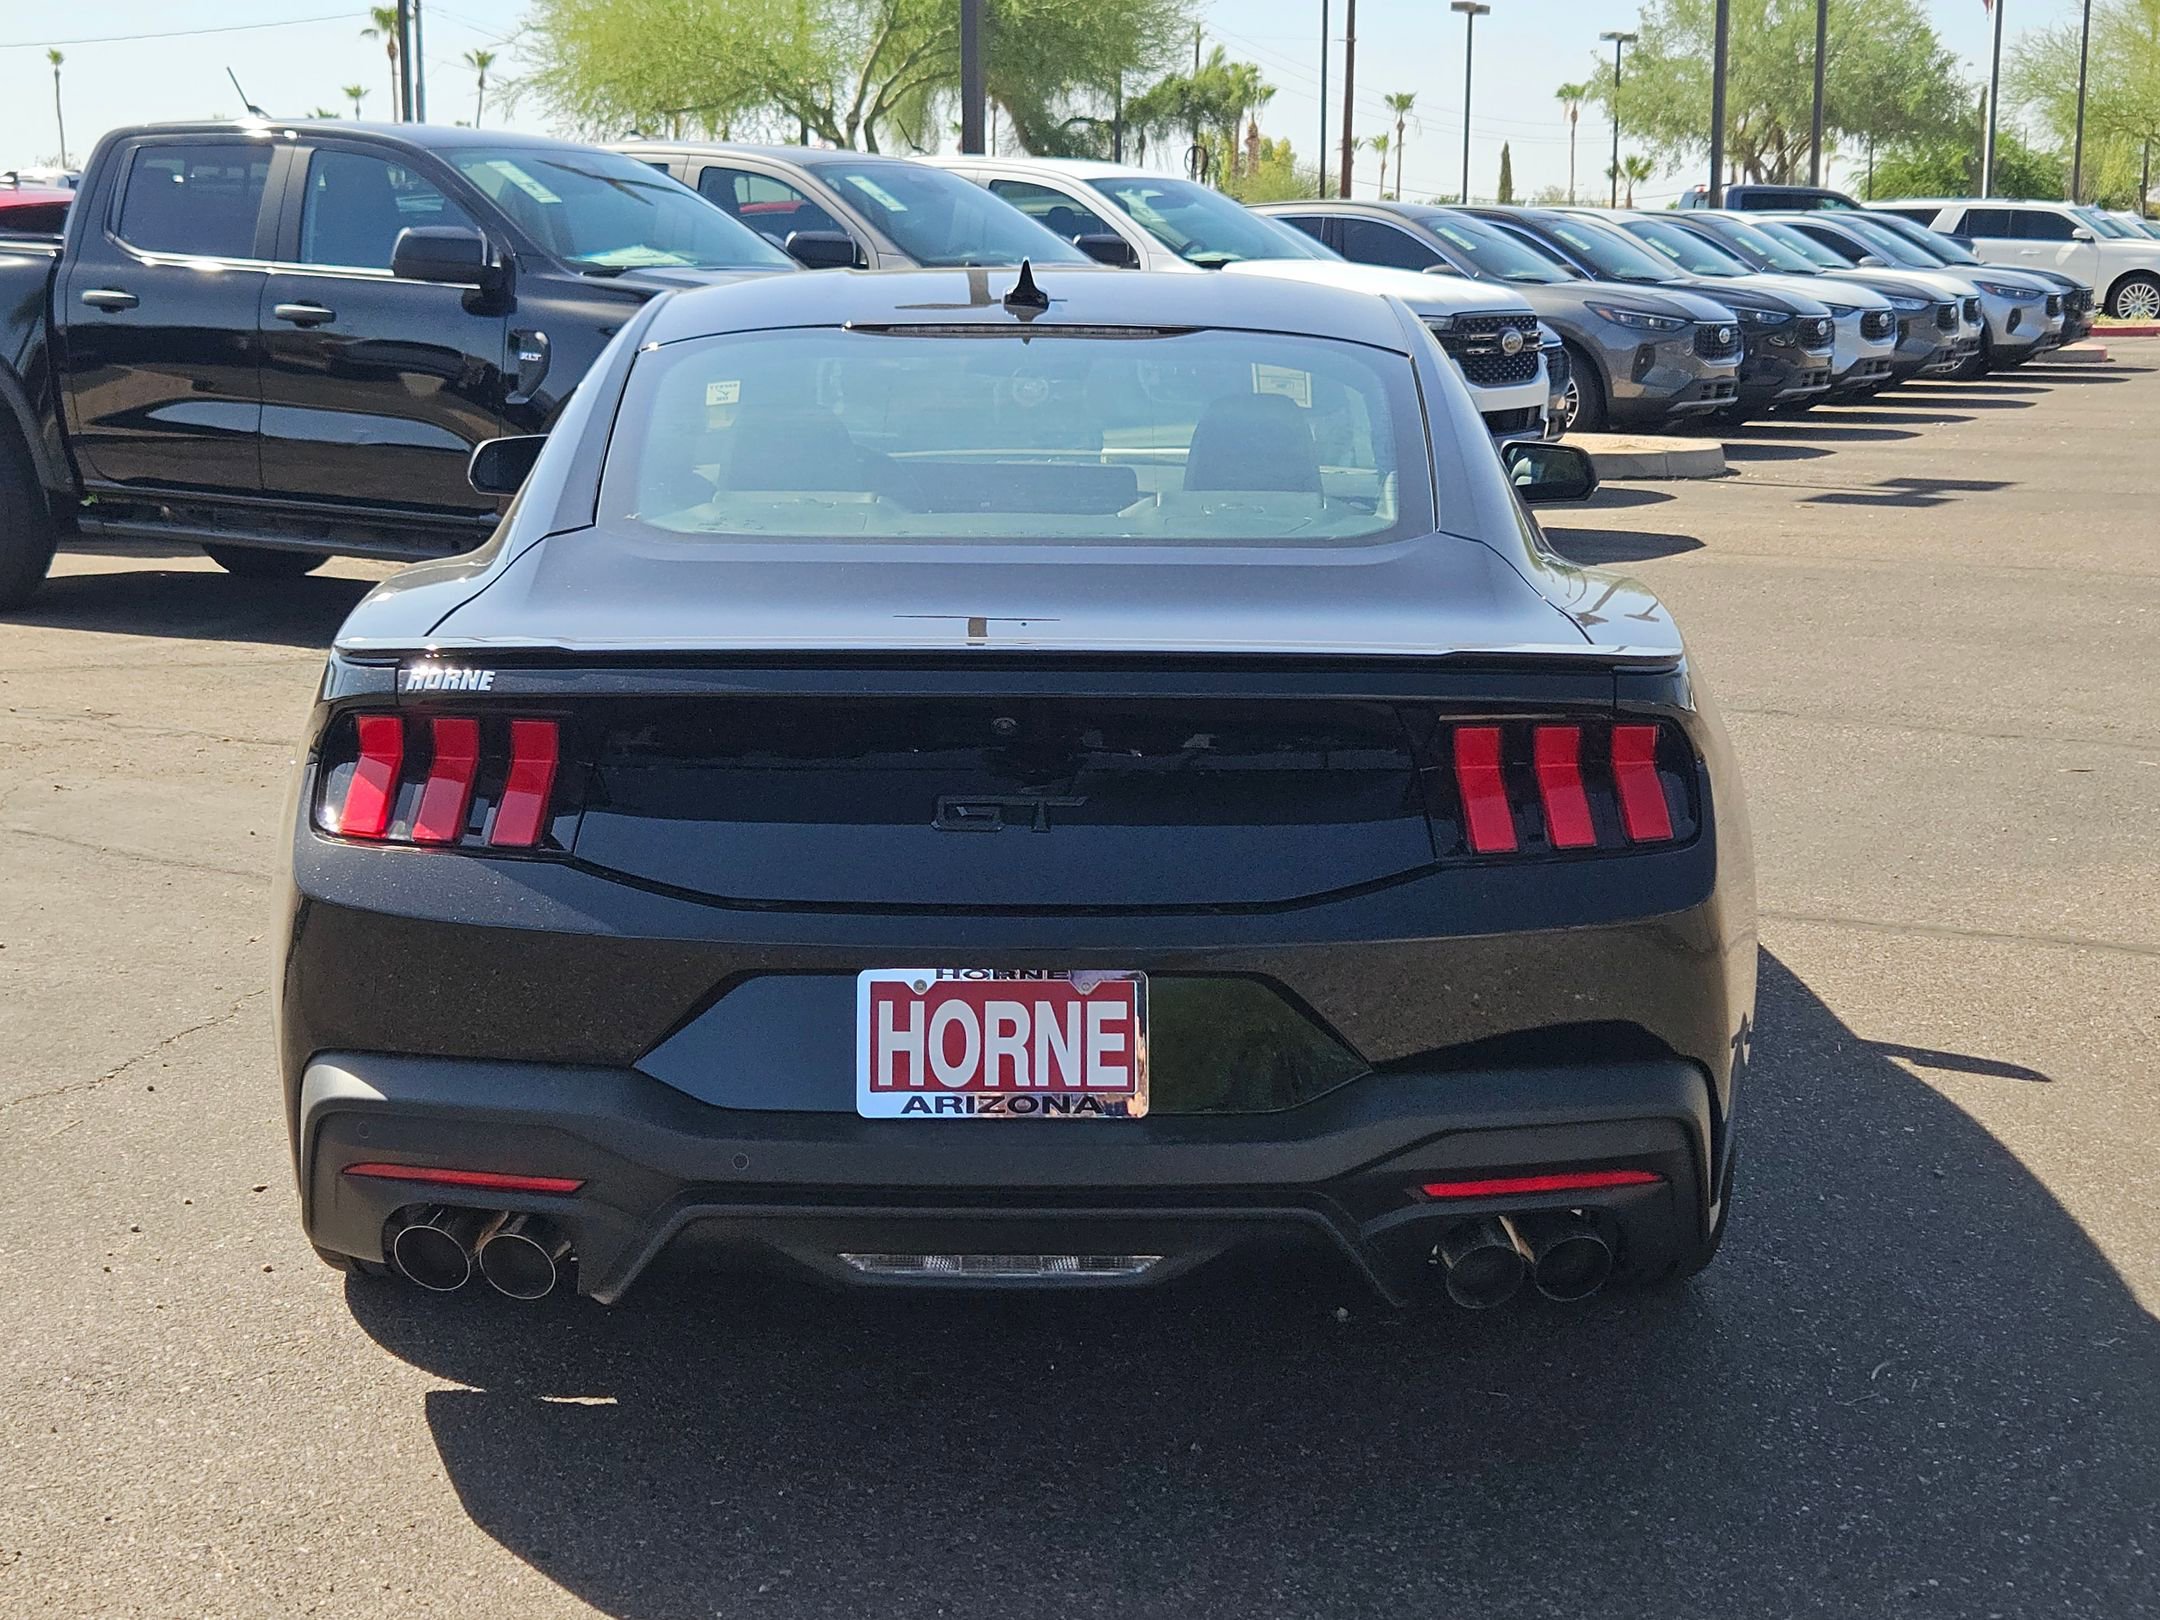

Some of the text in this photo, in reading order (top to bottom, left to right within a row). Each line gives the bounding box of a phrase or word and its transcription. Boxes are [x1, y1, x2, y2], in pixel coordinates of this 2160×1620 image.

[406, 667, 496, 691] HORNE
[931, 795, 1090, 832] GT
[936, 968, 1070, 980] HORNE
[878, 999, 1128, 1088] HORNE
[901, 1095, 1105, 1115] ARIZONA
